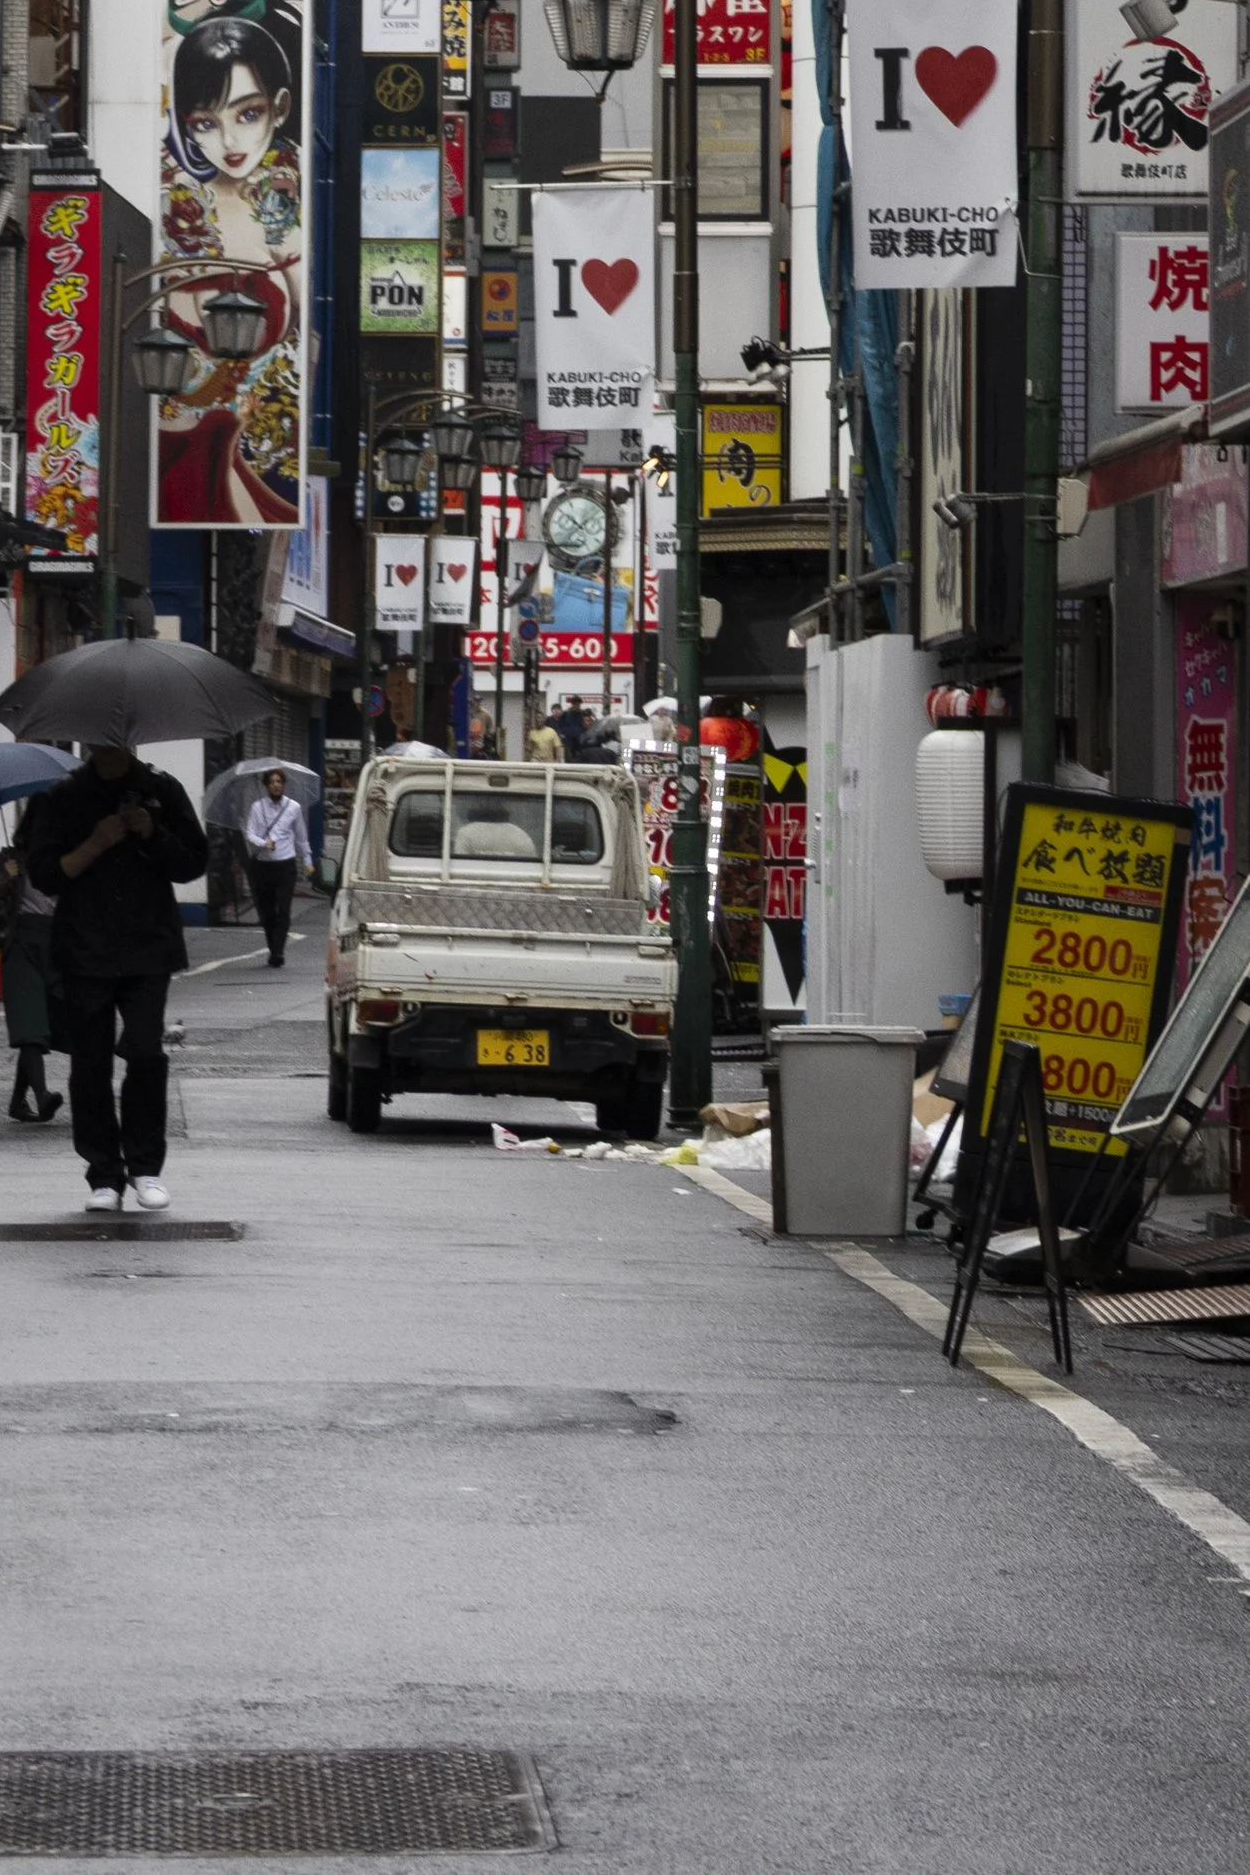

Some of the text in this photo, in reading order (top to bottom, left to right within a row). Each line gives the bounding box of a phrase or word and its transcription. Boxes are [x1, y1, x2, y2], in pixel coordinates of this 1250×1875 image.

[874, 47, 910, 131] I
[1121, 162, 1189, 181] 歌舞伎町店
[868, 206, 999, 225] KABUKI-CHO
[868, 228, 999, 259] 歌舞伎町
[371, 285, 425, 307] PON
[552, 259, 578, 318] I
[41, 196, 88, 483] ギラギラガールズ
[1148, 246, 1209, 402] 焼肉
[546, 371, 642, 384] KABUKI-CHO
[546, 386, 641, 408] 歌舞伎町
[1021, 838, 1168, 889] 食べ放題
[1023, 890, 1153, 920] ALL-YOU-CAN-EAT
[1031, 927, 1133, 977] 2800
[1022, 989, 1125, 1038] 3800
[1043, 1054, 1116, 1099] 800
